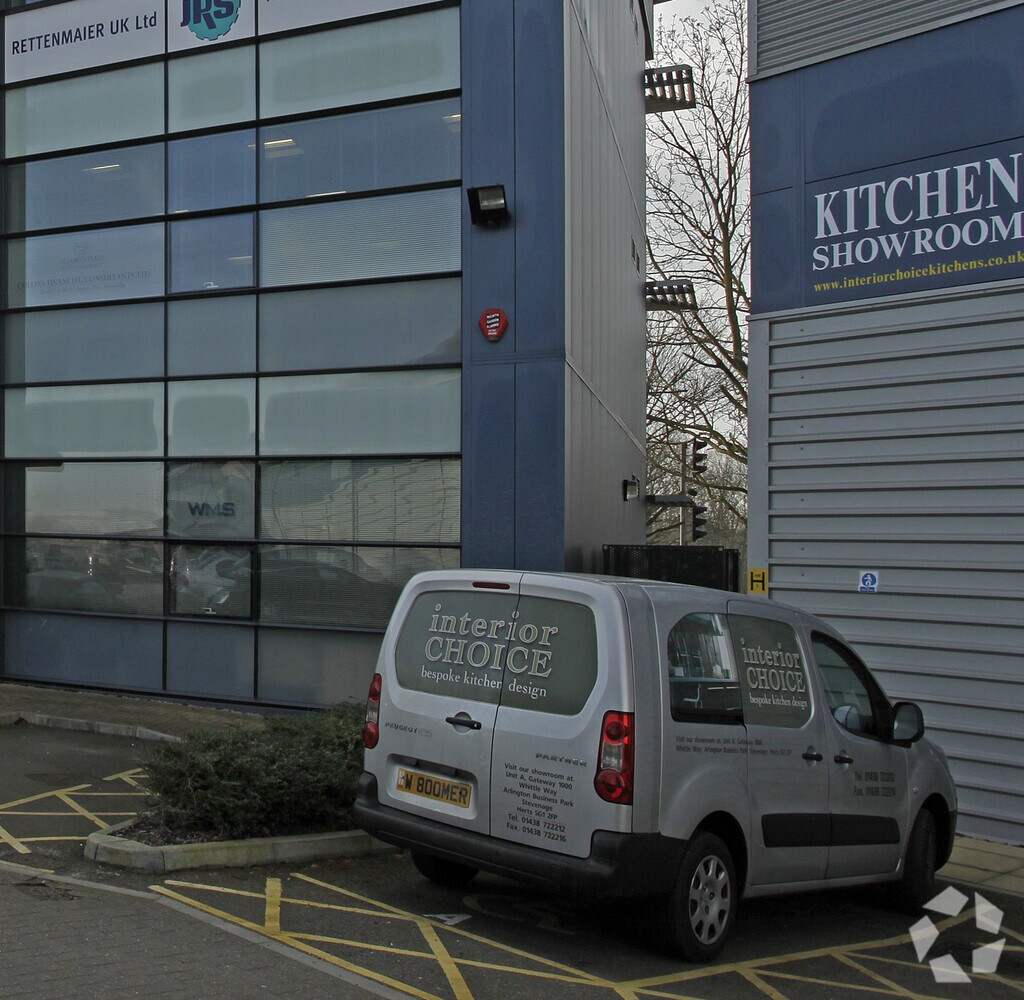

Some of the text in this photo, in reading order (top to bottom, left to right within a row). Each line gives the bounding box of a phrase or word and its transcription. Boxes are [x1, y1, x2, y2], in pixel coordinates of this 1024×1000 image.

[12, 11, 157, 55] RETTENMAIER UK Ltd
[814, 152, 1023, 240] KITCHEN
[812, 211, 1024, 271] SHOWROOM
[47, 277, 82, 287] FINANCIAL
[84, 272, 135, 283] CONSULTANTS
[136, 270, 151, 278] LTD
[814, 250, 1024, 292] www.interiorchoicekitchens.co.uk
[187, 502, 236, 517] WMS
[750, 571, 765, 591] H
[429, 603, 559, 646] interior
[425, 636, 552, 678] CHOICE
[740, 638, 800, 668] interior
[421, 665, 547, 699] bespoke kitchen design
[746, 667, 806, 693] CHOICE
[749, 692, 808, 710] bespoke kitchen design
[504, 762, 517, 771] Visit
[531, 768, 564, 780] showroom
[505, 771, 517, 779] Unit
[528, 776, 556, 787] Gateway
[558, 781, 573, 790] 1000
[503, 787, 574, 807] Arlington Business Park
[519, 782, 557, 796] Whittle Way
[516, 806, 532, 815] Herts
[535, 810, 546, 818] SG1
[521, 799, 553, 811] Stevenage
[506, 822, 519, 832] Fax.
[522, 826, 541, 837] 01438
[521, 816, 541, 827] 01438
[543, 822, 566, 832] 722212
